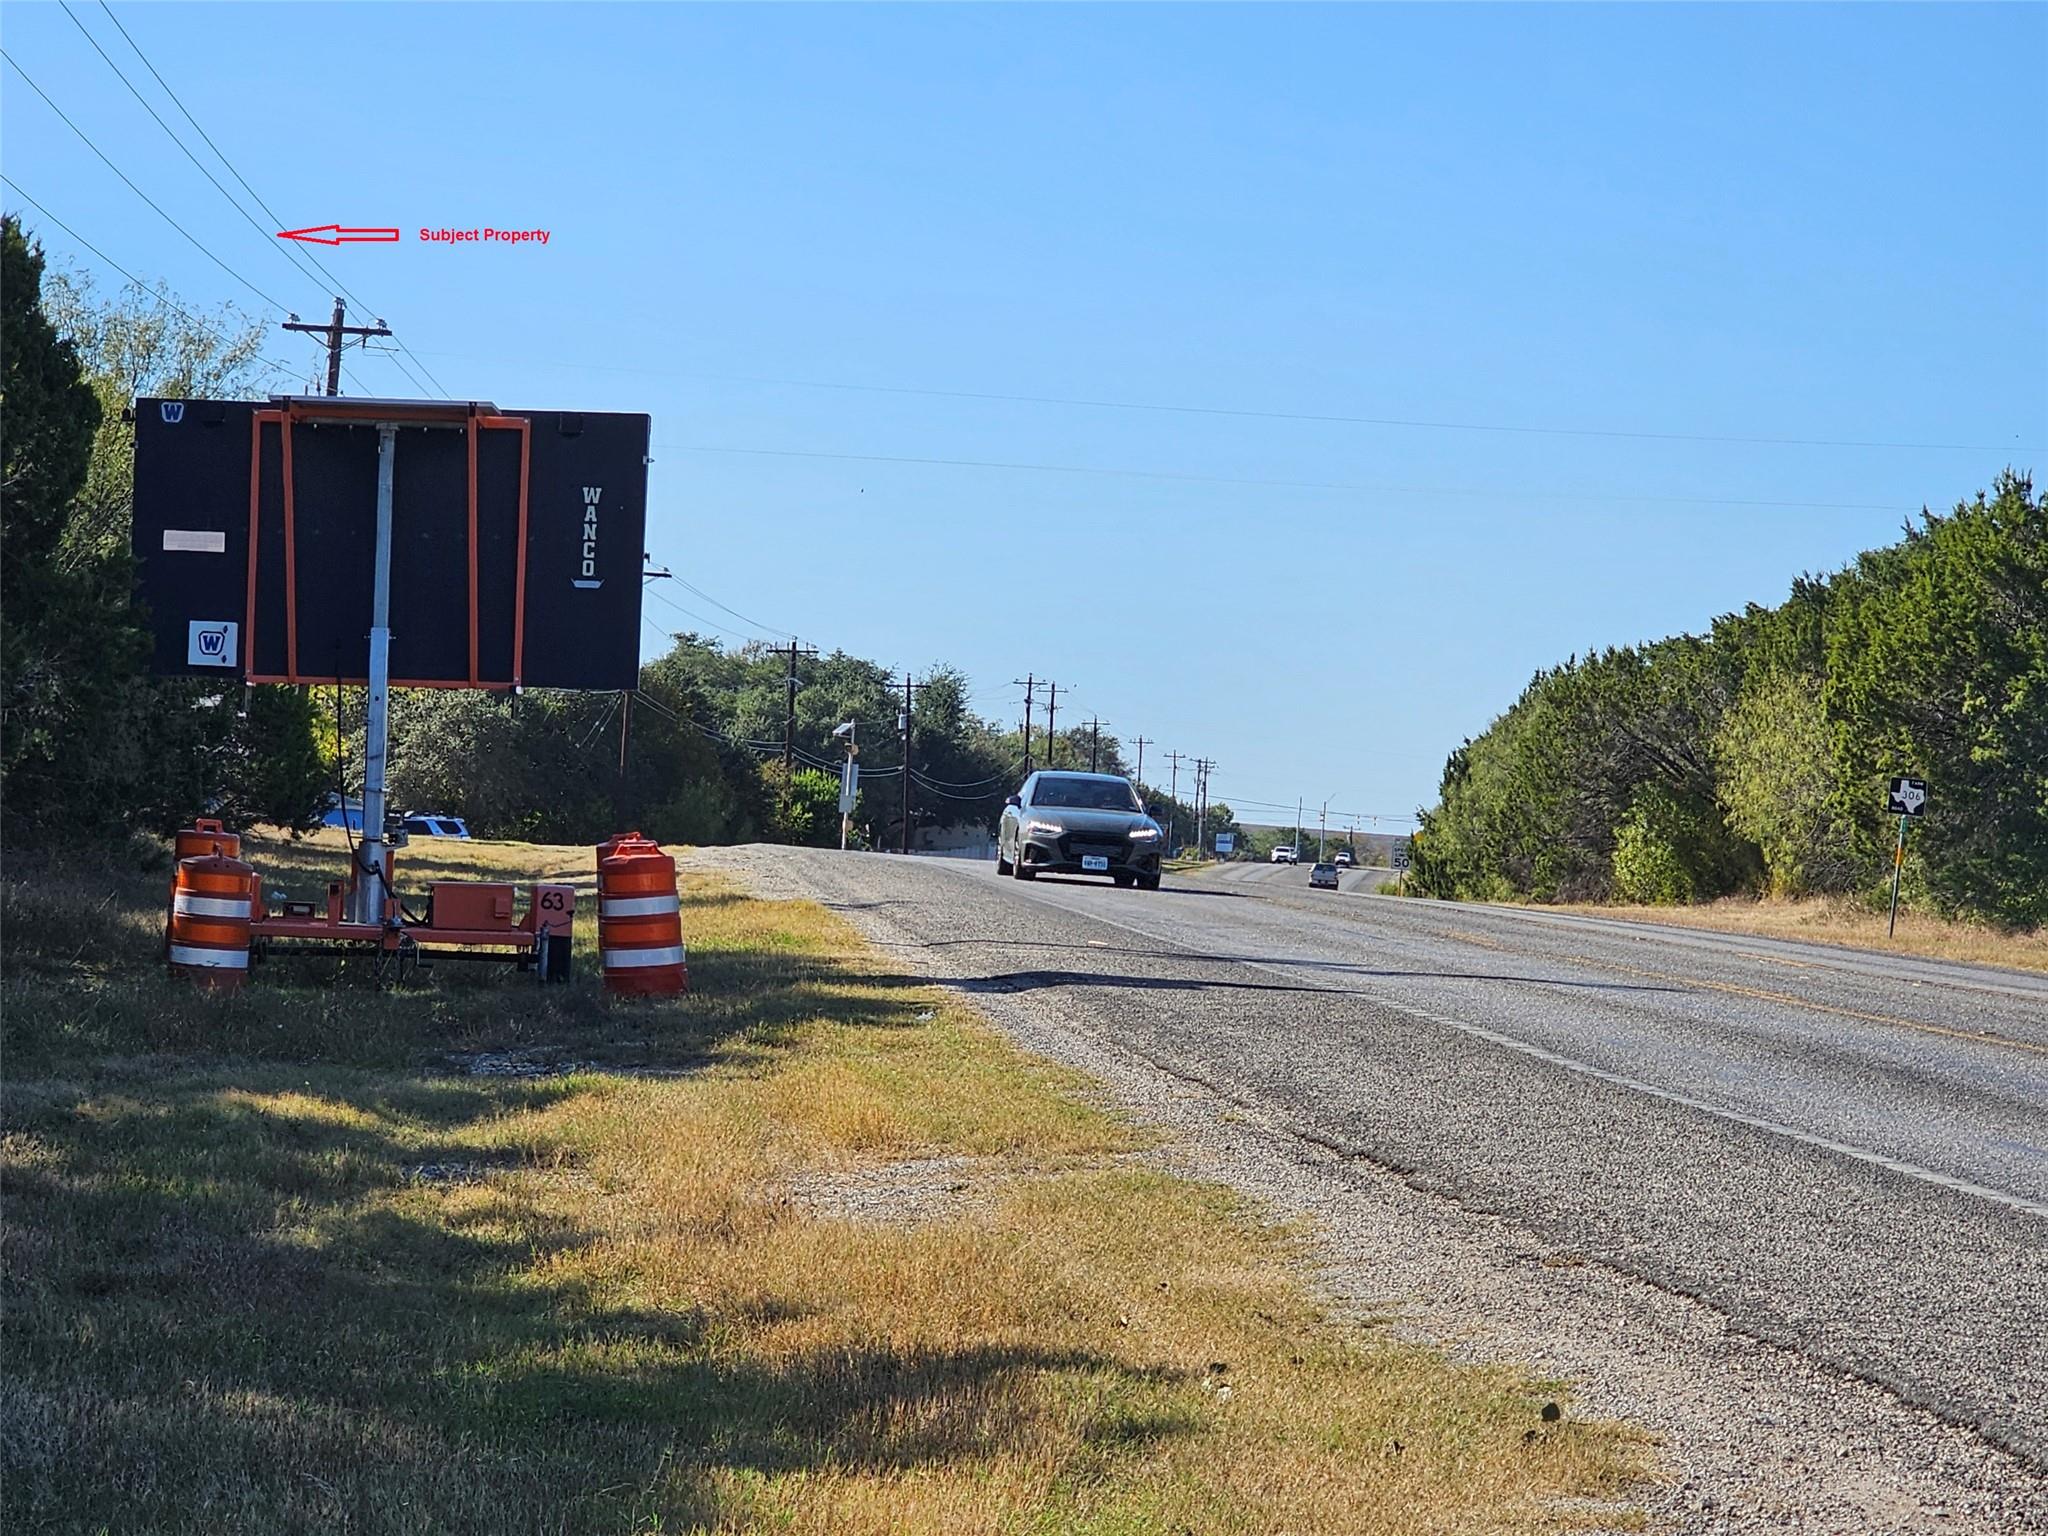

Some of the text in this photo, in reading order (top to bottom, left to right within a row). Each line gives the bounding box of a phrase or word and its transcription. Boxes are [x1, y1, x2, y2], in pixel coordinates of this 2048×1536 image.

[162, 403, 183, 421] W
[582, 487, 602, 576] WANCO
[202, 635, 221, 652] W
[1902, 790, 1921, 801] 306
[1394, 858, 1410, 868] 50
[541, 892, 564, 911] 63
